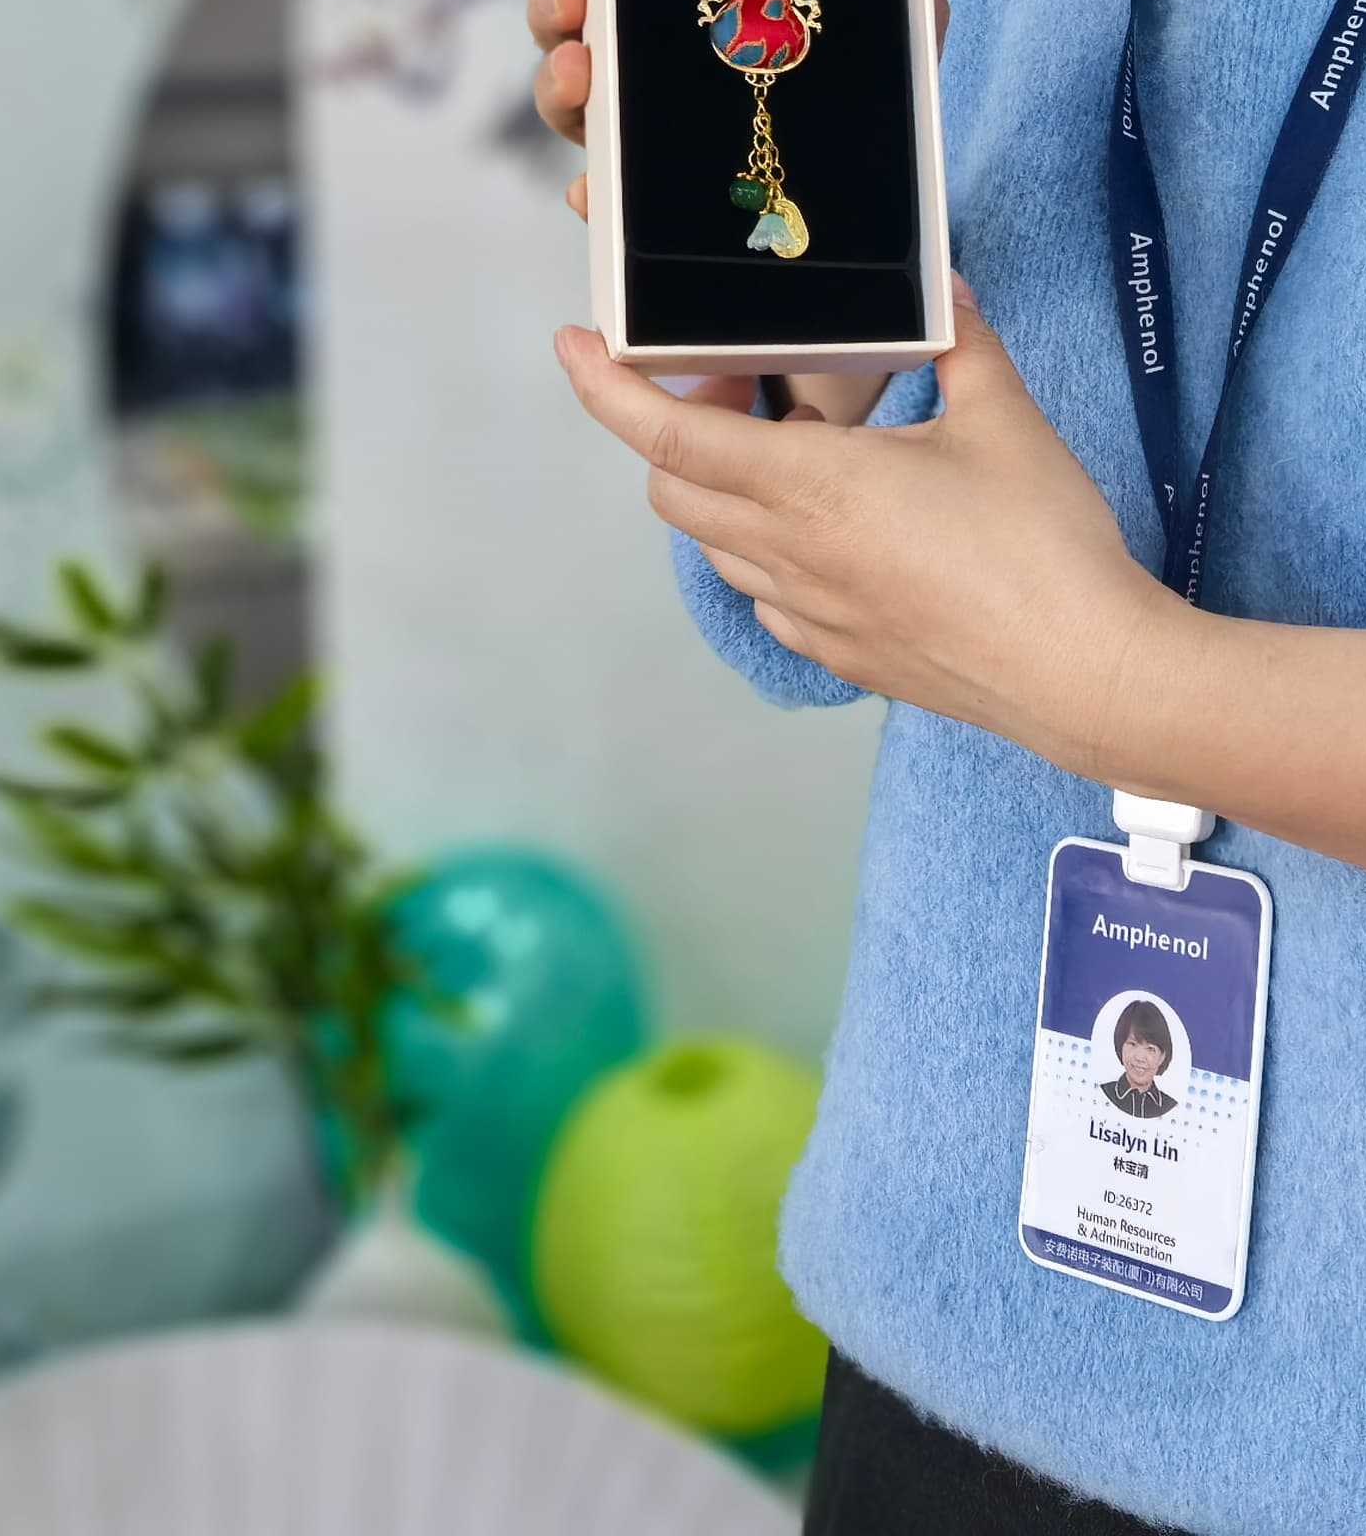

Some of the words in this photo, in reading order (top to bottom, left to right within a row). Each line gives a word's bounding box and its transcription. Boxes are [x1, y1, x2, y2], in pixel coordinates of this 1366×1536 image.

[1129, 231, 1164, 374] Amphenol
[1186, 473, 1210, 603] mphenol
[1092, 913, 1209, 961] Amphenol
[1089, 1119, 1148, 1154] Lisalyn
[1153, 1137, 1179, 1162] Lin
[1077, 1205, 1117, 1229] Human
[1120, 1218, 1177, 1247] Resources
[1077, 1223, 1088, 1238] &
[1090, 1227, 1173, 1265] Administration
